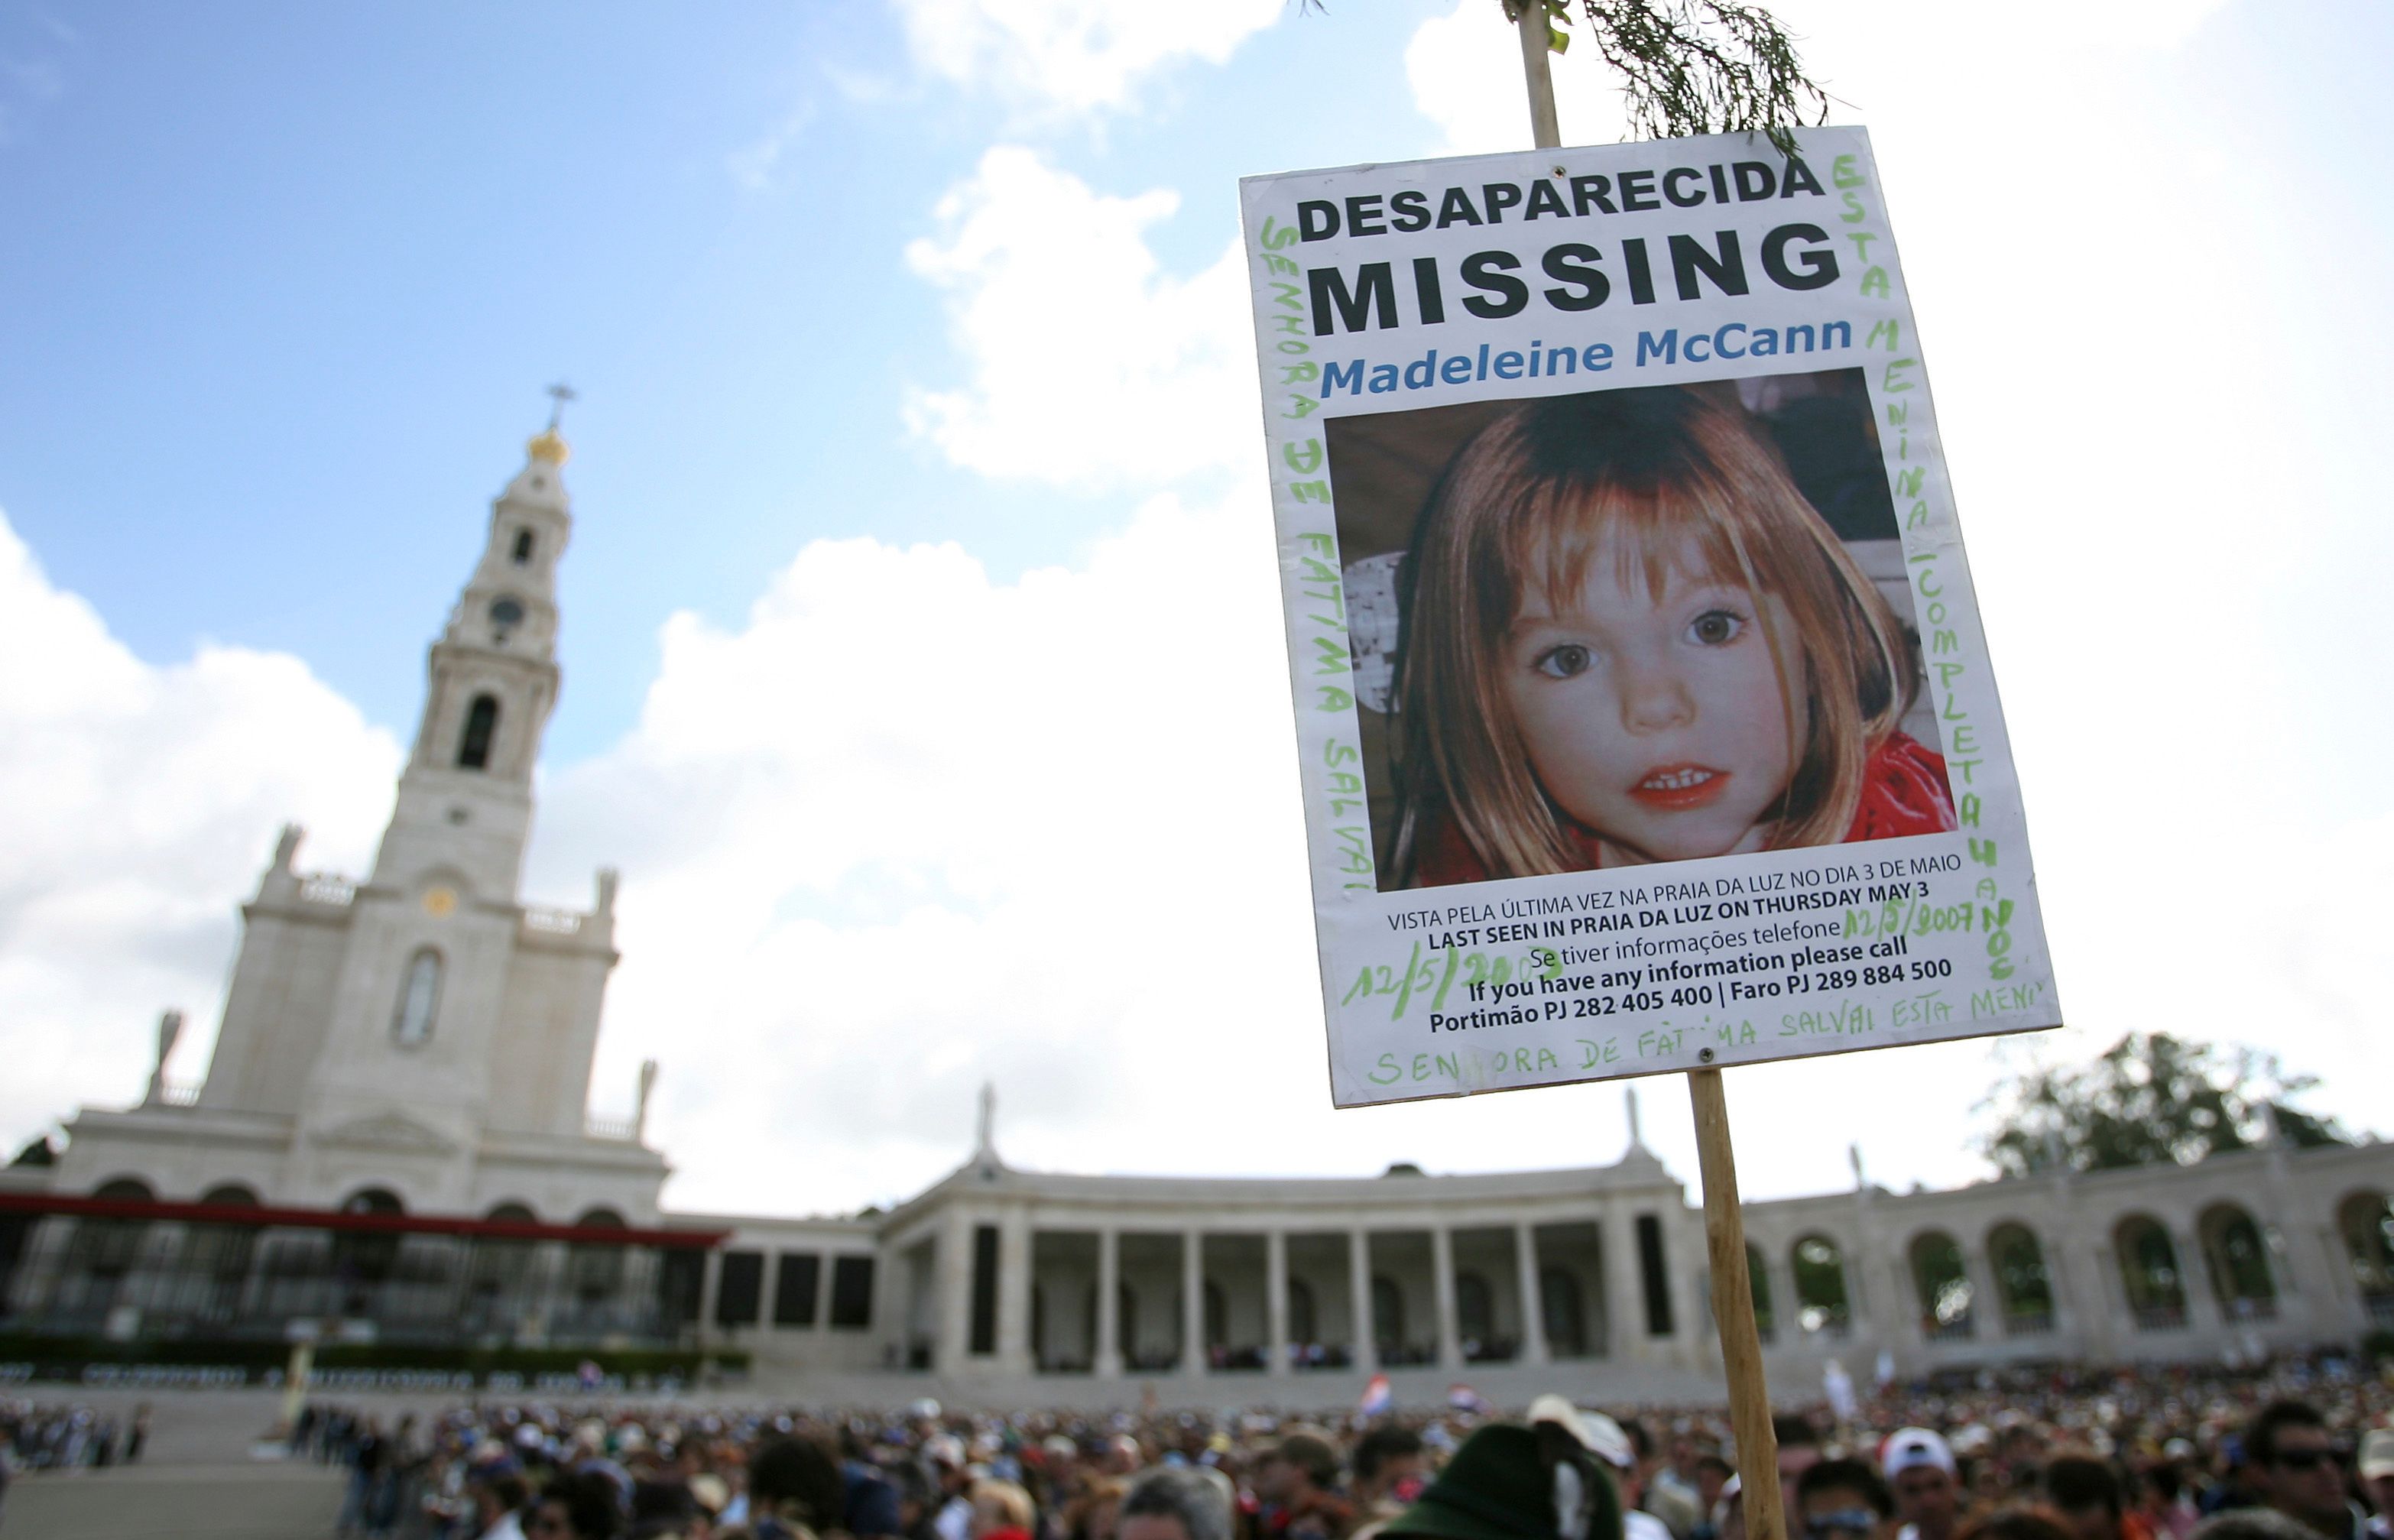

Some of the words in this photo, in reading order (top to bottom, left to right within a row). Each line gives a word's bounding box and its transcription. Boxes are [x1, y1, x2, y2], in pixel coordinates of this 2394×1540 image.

[1296, 157, 1826, 242] DESAPARECIDA
[1260, 215, 1321, 420] SENHORA
[1307, 222, 1841, 337] MISSING
[1320, 340, 1614, 399] Madeleine
[1637, 320, 1851, 367] McCann
[1283, 437, 1333, 504] DE
[1834, 153, 1891, 300] ESTA
[1919, 568, 1982, 828] COMPLETA
[1387, 910, 1442, 931] VISTA
[1447, 904, 1496, 925] PELA
[1501, 896, 1574, 919] ÚLTIMA
[1577, 891, 1615, 911] VEZ
[1620, 888, 1649, 906] NA
[1653, 881, 1711, 903] PRAIA
[1716, 878, 1744, 896] DA
[1749, 873, 1786, 893] LUZ
[1790, 869, 1820, 888] NO
[1825, 865, 1860, 884] DIA
[1864, 864, 1874, 880] 3
[1880, 860, 1906, 878] DE
[1910, 854, 1961, 875] MAIO
[1429, 929, 1481, 950] LAST
[1486, 922, 1538, 944] SEEN
[1543, 919, 1565, 938] IN
[1570, 913, 1634, 935] PRAIA
[1639, 909, 1669, 928] DA
[1674, 904, 1714, 924] LUZ
[1718, 900, 1750, 919] ON
[1753, 887, 1862, 915] THURSDAY
[1868, 882, 1911, 903] MAY
[1917, 881, 1929, 897] 3
[1468, 980, 1485, 1002] If
[1490, 981, 1534, 1005] you
[1539, 974, 1595, 994] have
[1601, 970, 1642, 990] any
[1647, 952, 1786, 983] information
[1791, 945, 1864, 973] please
[1869, 934, 1908, 958] call
[1530, 948, 1555, 968] Se
[1561, 945, 1610, 965] tiver
[1615, 930, 1747, 959] informações
[1753, 919, 1841, 945] telefone
[1430, 1004, 1539, 1033] Portimão
[1544, 1000, 1567, 1021] PJ
[1573, 996, 1617, 1018] 282
[1621, 990, 1664, 1012] 405
[1670, 985, 1712, 1007] 400
[1731, 981, 1781, 1000] Faro
[1786, 974, 1810, 994] PJ
[1815, 969, 1857, 991] 289
[1863, 964, 1906, 986] 884
[1911, 958, 1952, 981] 500
[1368, 1048, 1559, 1086] SENORA
[1576, 1037, 1620, 1071] DE
[1779, 1000, 1875, 1037] SALVAI
[1891, 989, 1953, 1027] ESTA
